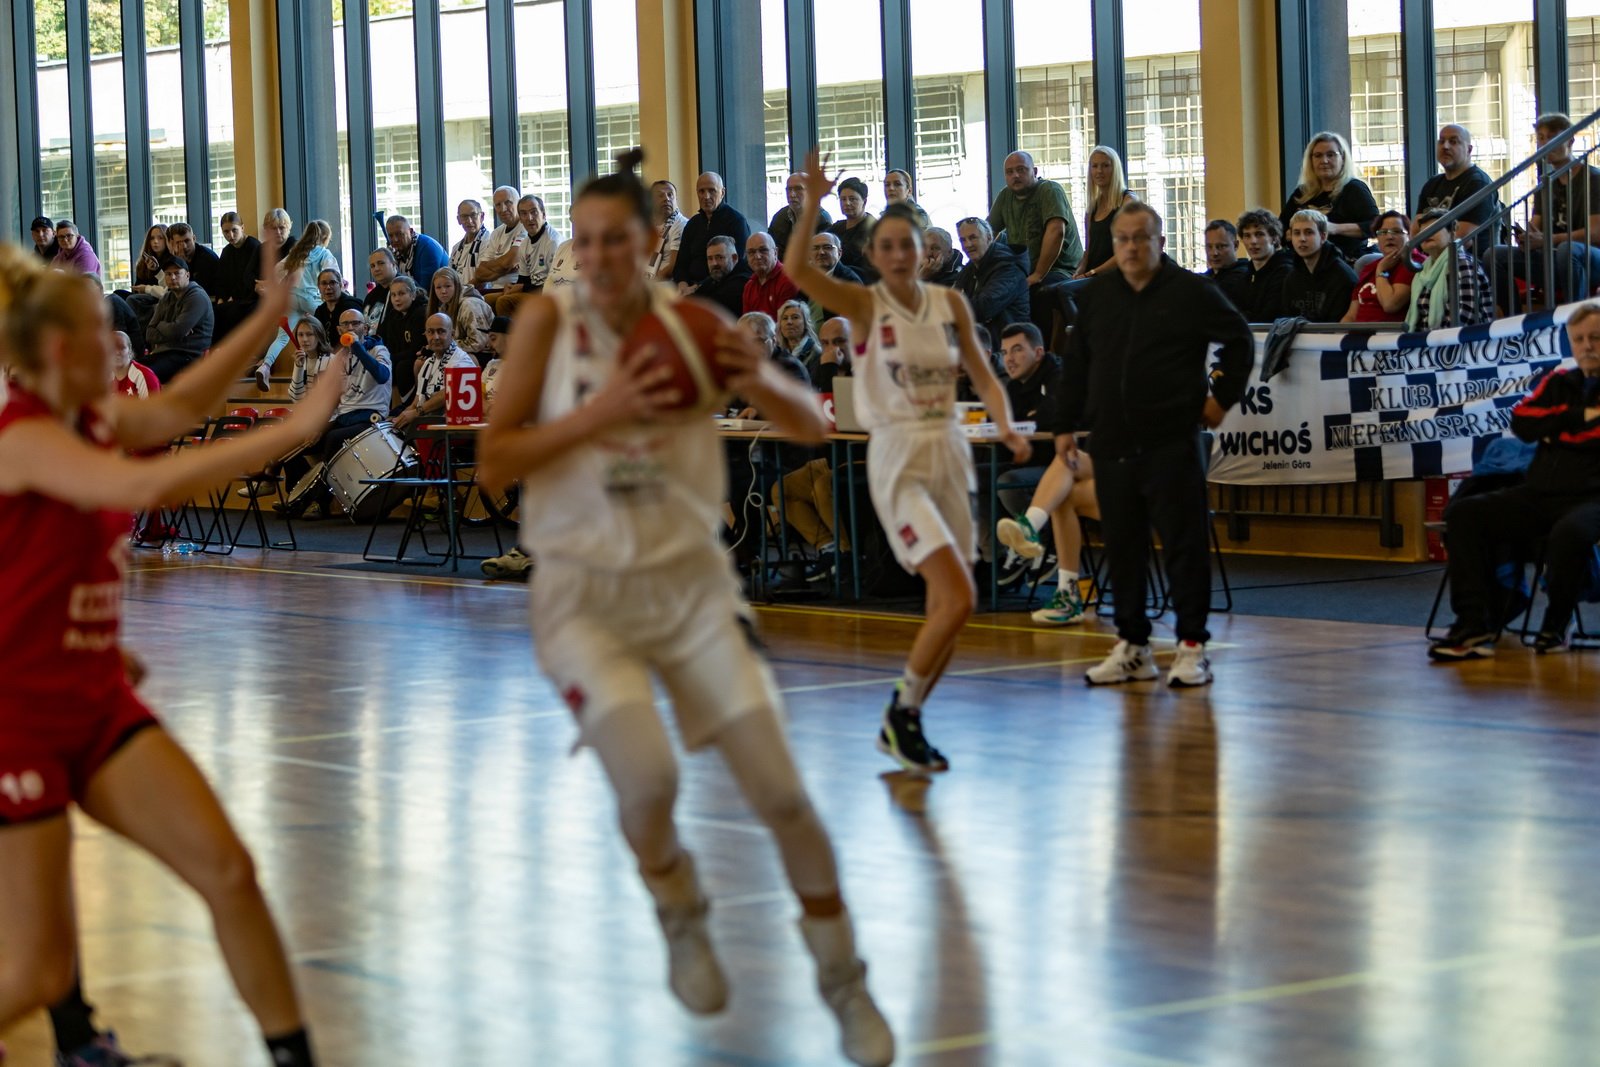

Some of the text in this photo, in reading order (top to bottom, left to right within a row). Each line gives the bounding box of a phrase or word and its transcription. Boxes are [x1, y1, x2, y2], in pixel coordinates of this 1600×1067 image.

[457, 373, 477, 411] 5
[1369, 382, 1434, 411] KLUB
[1219, 421, 1313, 457] WICHOŚ
[1291, 460, 1312, 469] Góra
